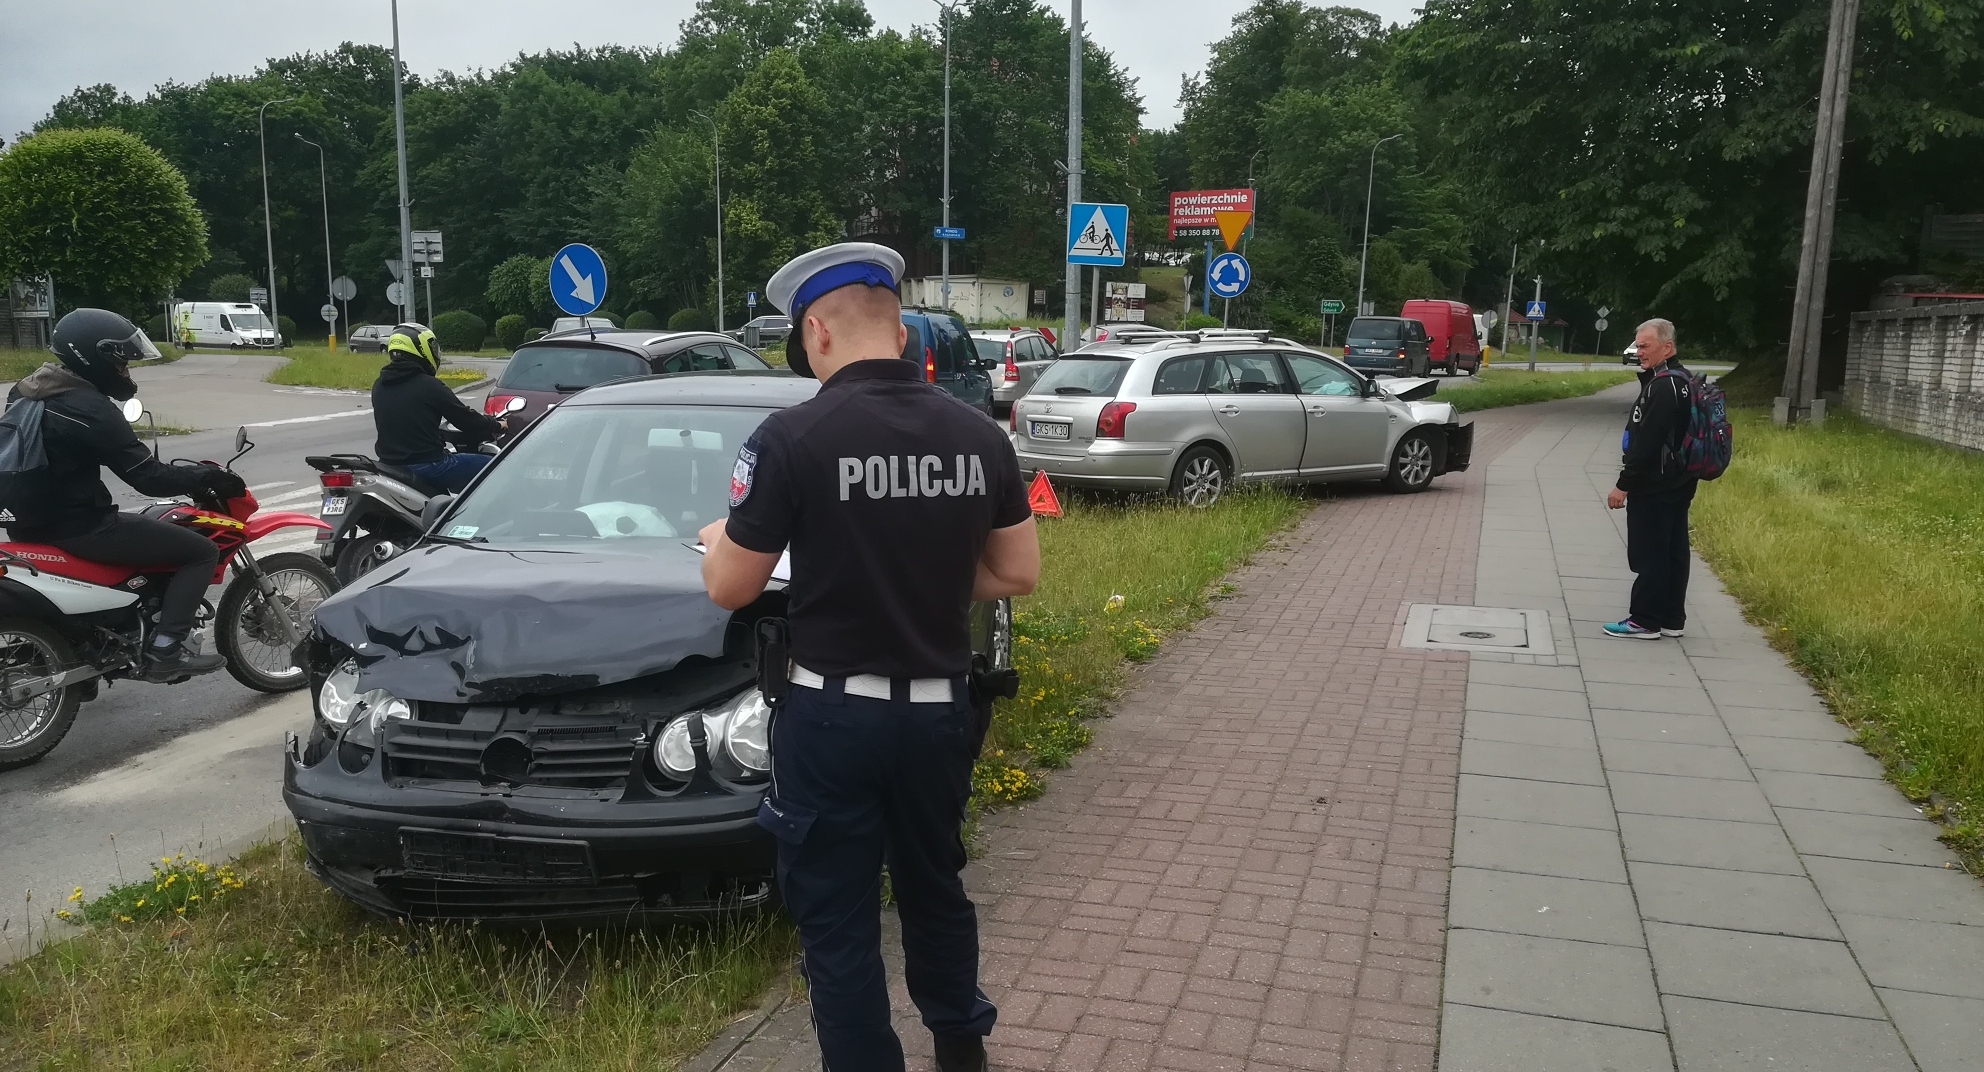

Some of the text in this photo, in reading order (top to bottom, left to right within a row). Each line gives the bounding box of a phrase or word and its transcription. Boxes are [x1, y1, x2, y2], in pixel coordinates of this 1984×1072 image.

[1174, 192, 1248, 207] powierzchnie
[1174, 217, 1202, 225] najlepsze
[1036, 424, 1049, 435] GKS
[838, 454, 987, 501] POLICJA
[16, 551, 67, 563] HONDA
